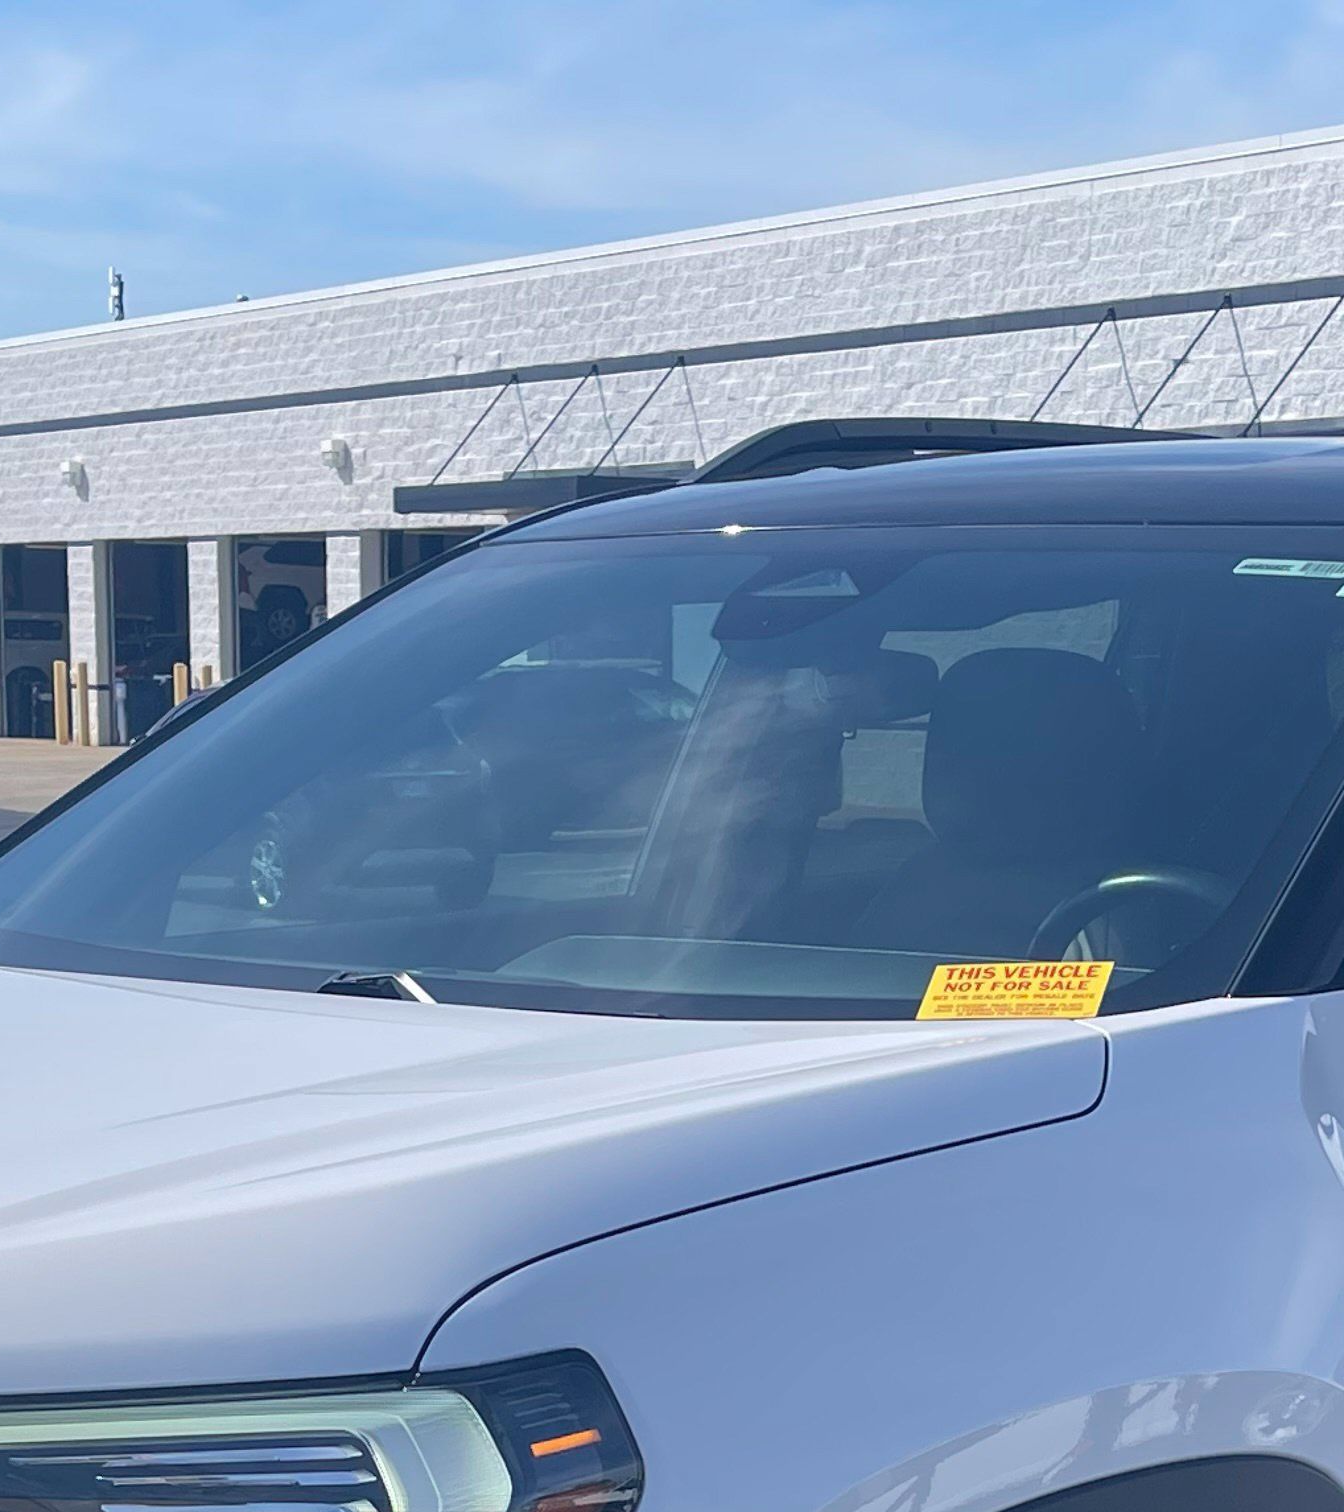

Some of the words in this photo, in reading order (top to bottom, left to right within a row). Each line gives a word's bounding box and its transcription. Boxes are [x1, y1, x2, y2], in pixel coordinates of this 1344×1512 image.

[946, 967, 996, 981] THIS
[1003, 964, 1102, 979] VEHICLE
[943, 982, 985, 993] NOT
[990, 981, 1032, 992] FOR
[1038, 980, 1090, 991] SALE
